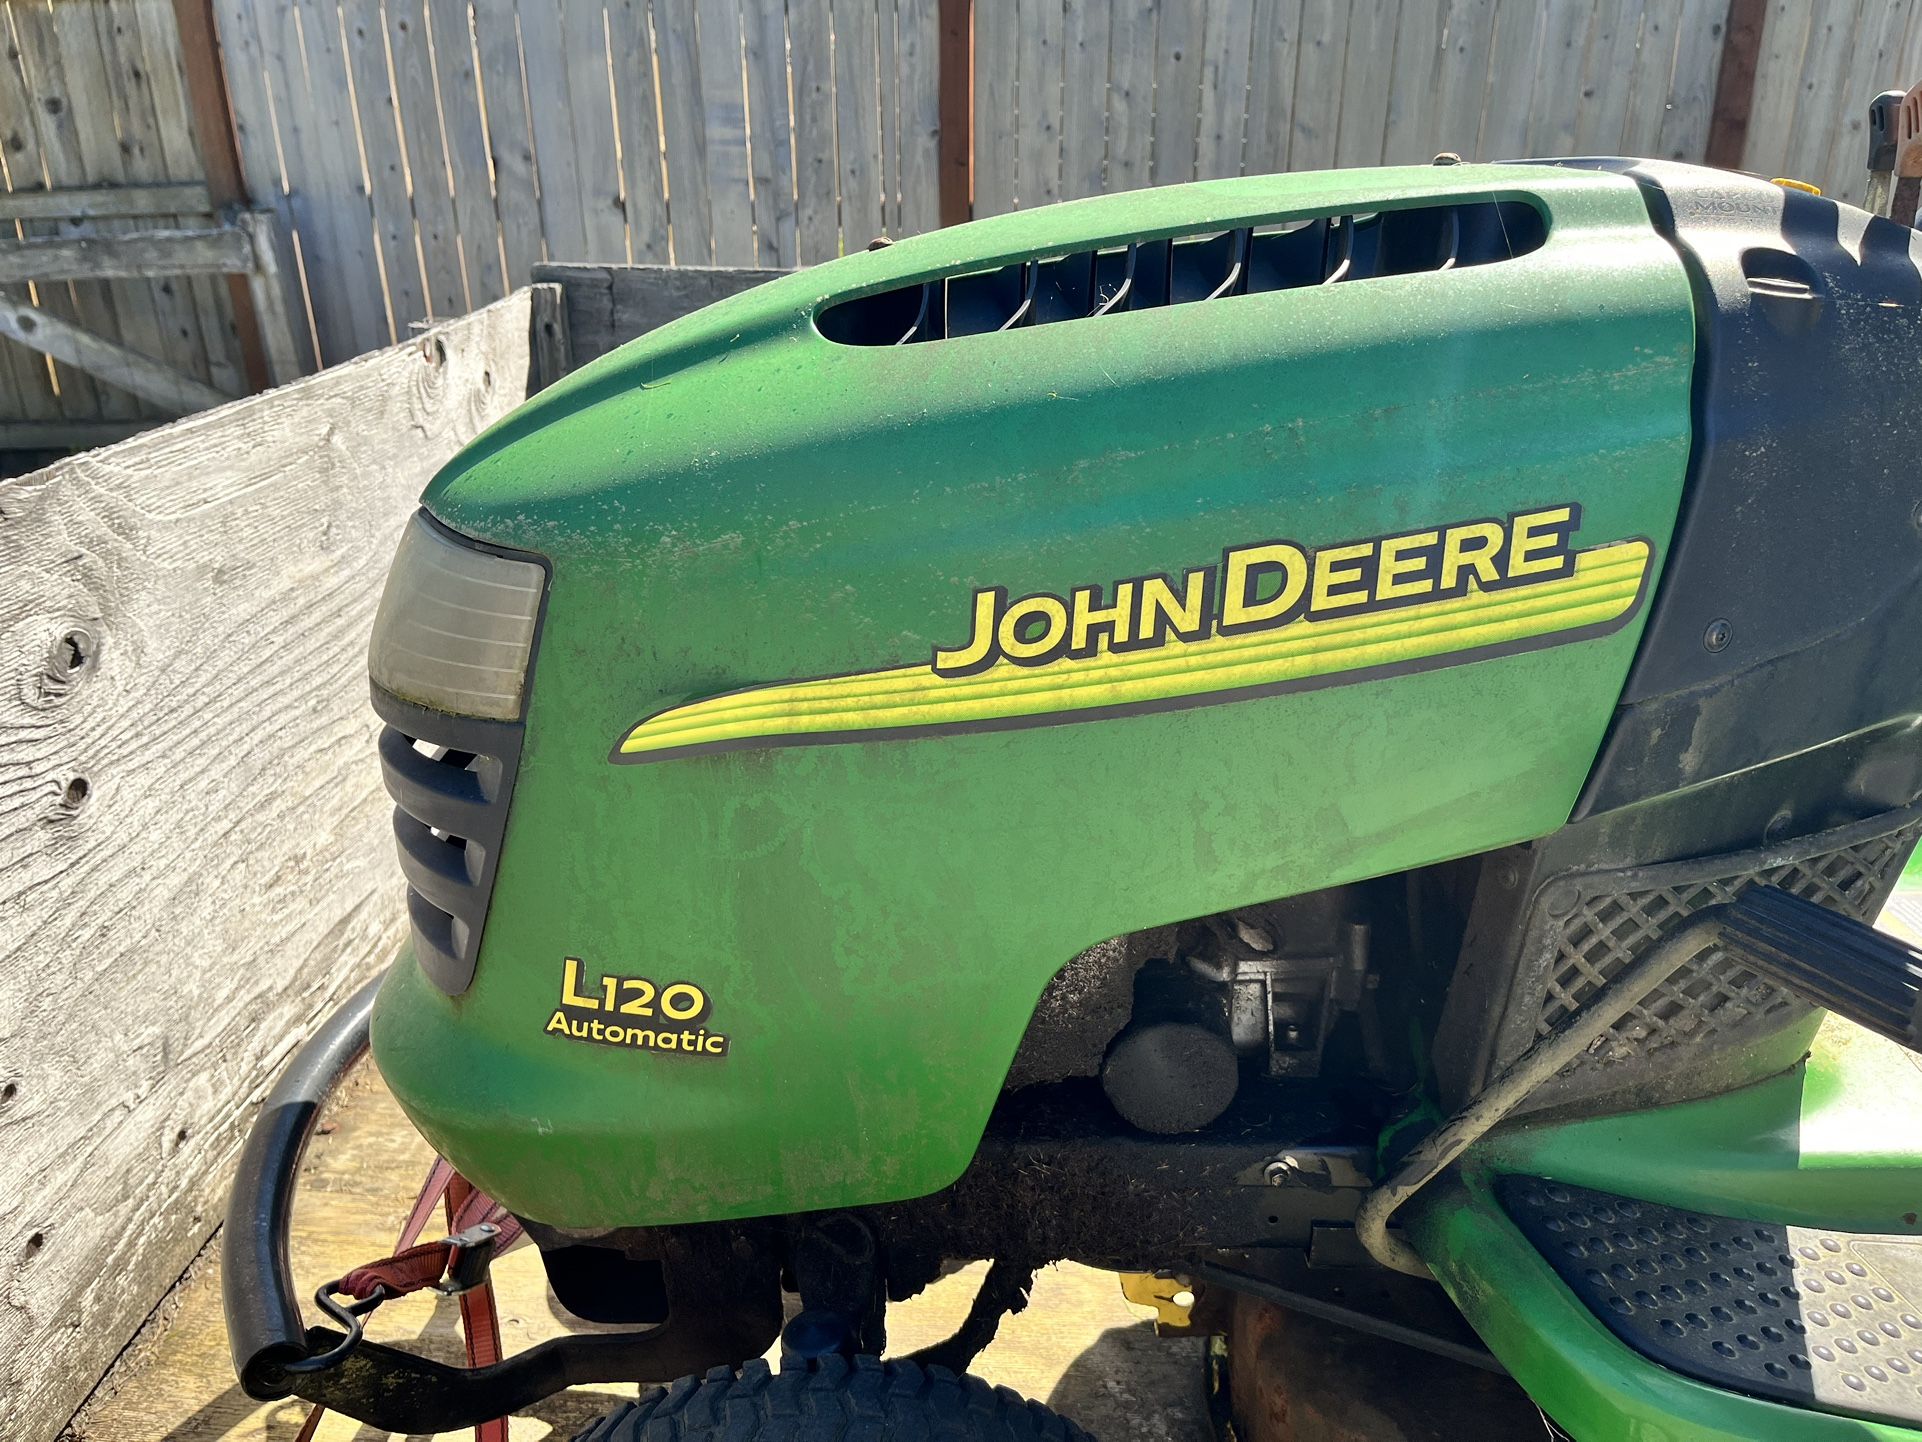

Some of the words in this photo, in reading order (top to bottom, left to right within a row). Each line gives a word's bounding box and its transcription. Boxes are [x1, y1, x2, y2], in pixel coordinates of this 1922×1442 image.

[933, 571, 1213, 670] JOHN
[1221, 507, 1573, 628] DEERE
[561, 959, 704, 1020] L120
[546, 1011, 724, 1053] Automatic
